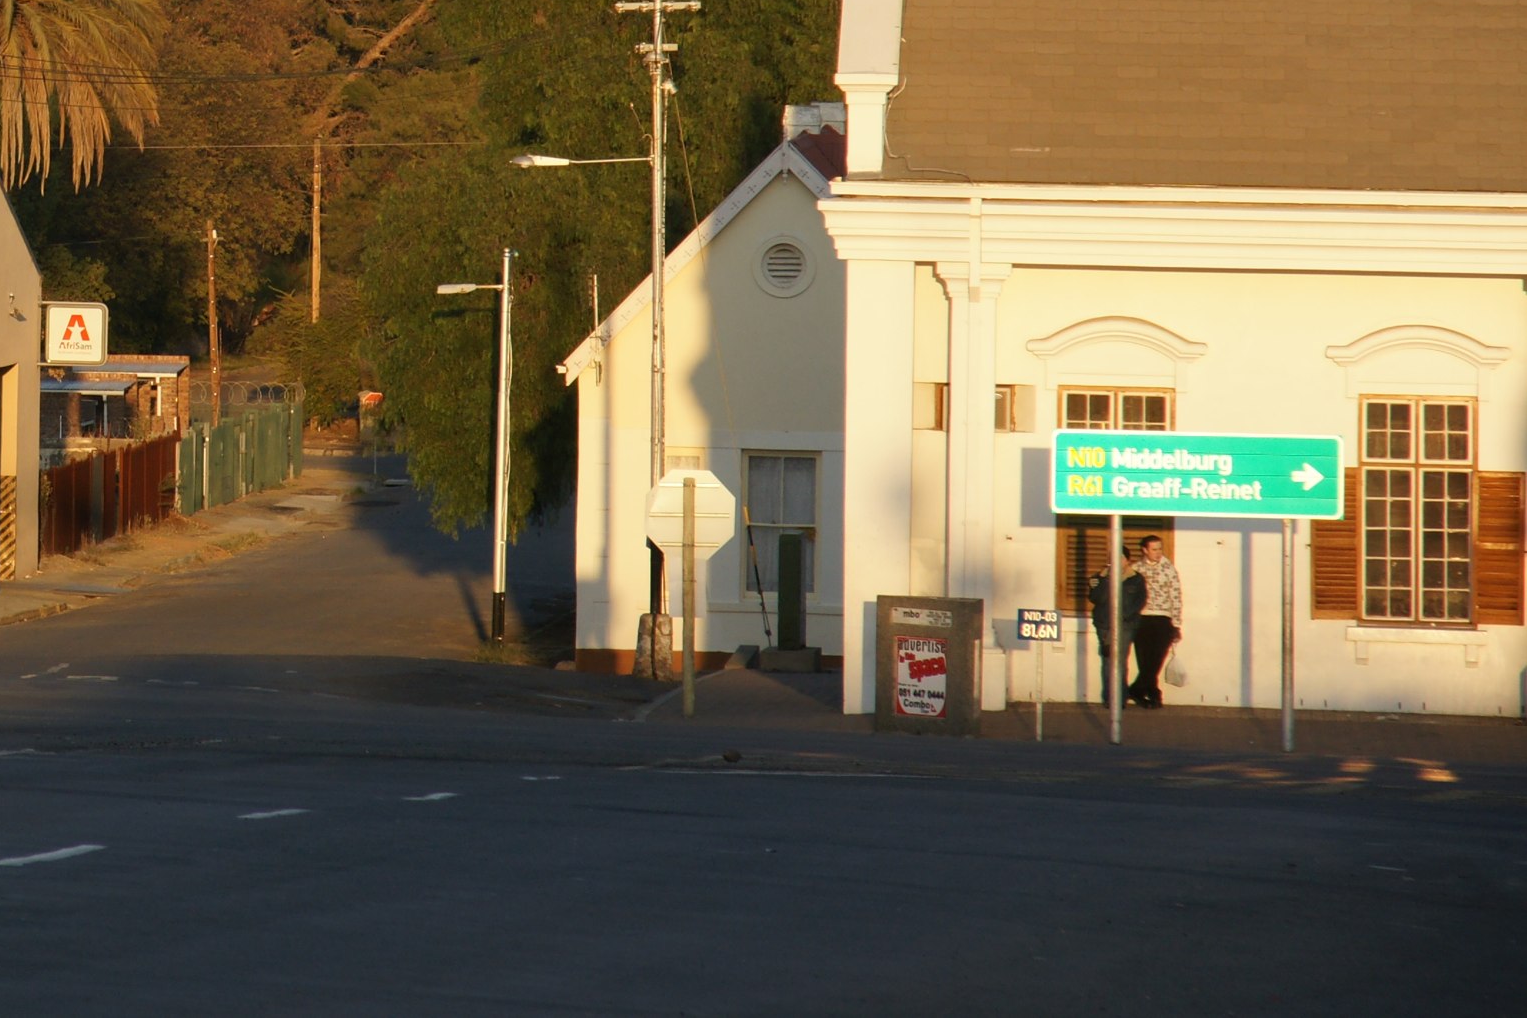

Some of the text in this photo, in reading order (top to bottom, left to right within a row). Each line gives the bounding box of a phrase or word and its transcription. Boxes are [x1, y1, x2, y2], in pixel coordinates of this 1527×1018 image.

[59, 341, 92, 350] AfriSam
[1067, 446, 1233, 476] N10 Middelburg
[1067, 474, 1263, 501] R61 Graaff-Reinet
[1024, 611, 1058, 622] N10-03
[898, 639, 946, 654] advertise
[903, 698, 931, 709] Combo
